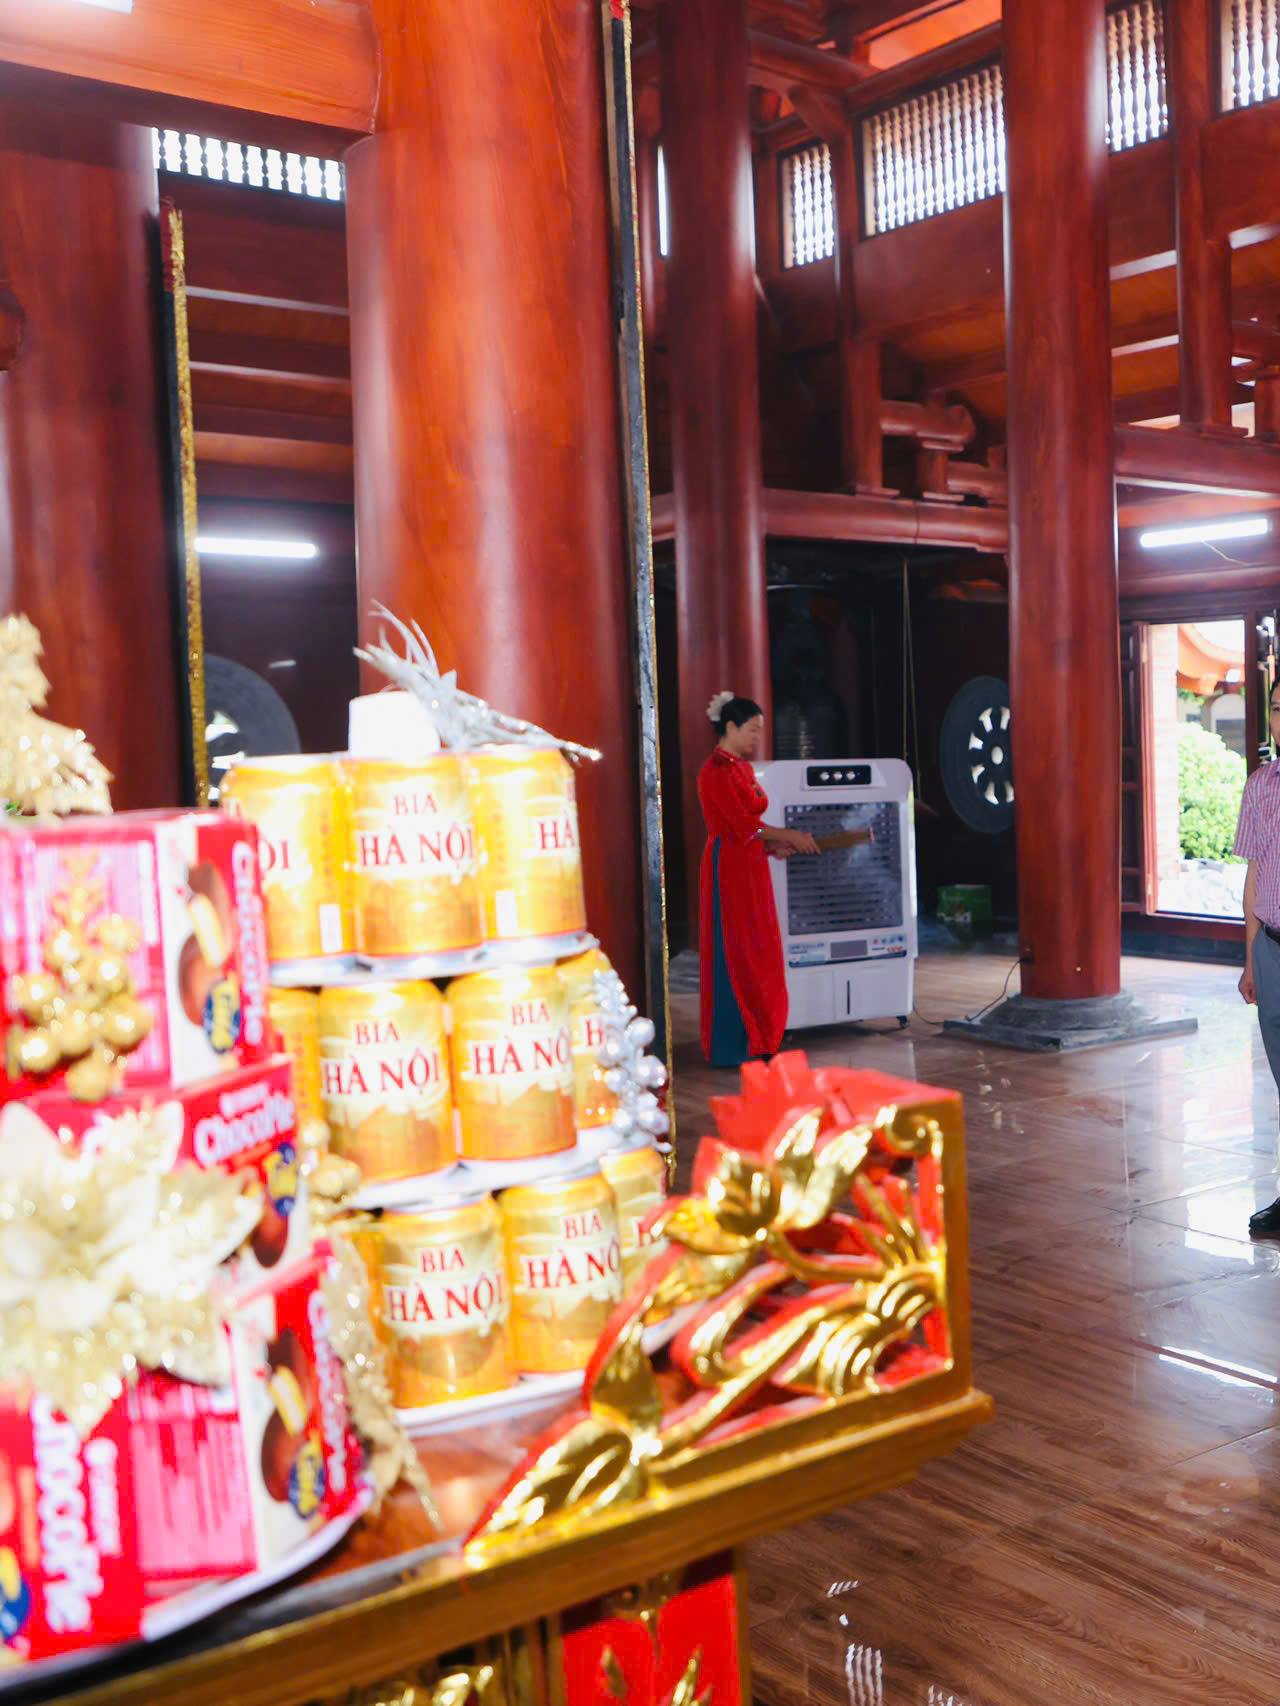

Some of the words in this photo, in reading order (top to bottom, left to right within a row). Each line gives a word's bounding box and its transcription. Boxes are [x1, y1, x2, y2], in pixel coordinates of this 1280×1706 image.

[394, 792, 438, 815] BIA
[361, 825, 407, 866] HÀ
[418, 821, 475, 869] NỘI
[512, 1001, 551, 1026] BIA
[355, 1021, 400, 1045] BIA
[324, 1053, 369, 1095] HÀ
[380, 1046, 440, 1095] NỘI
[474, 1034, 523, 1075] HÀ
[564, 1211, 602, 1240] BIA
[421, 1248, 465, 1273] BIA
[527, 1248, 577, 1289] HÀ
[388, 1281, 434, 1322] HÀ
[446, 1271, 503, 1320] NỘI
